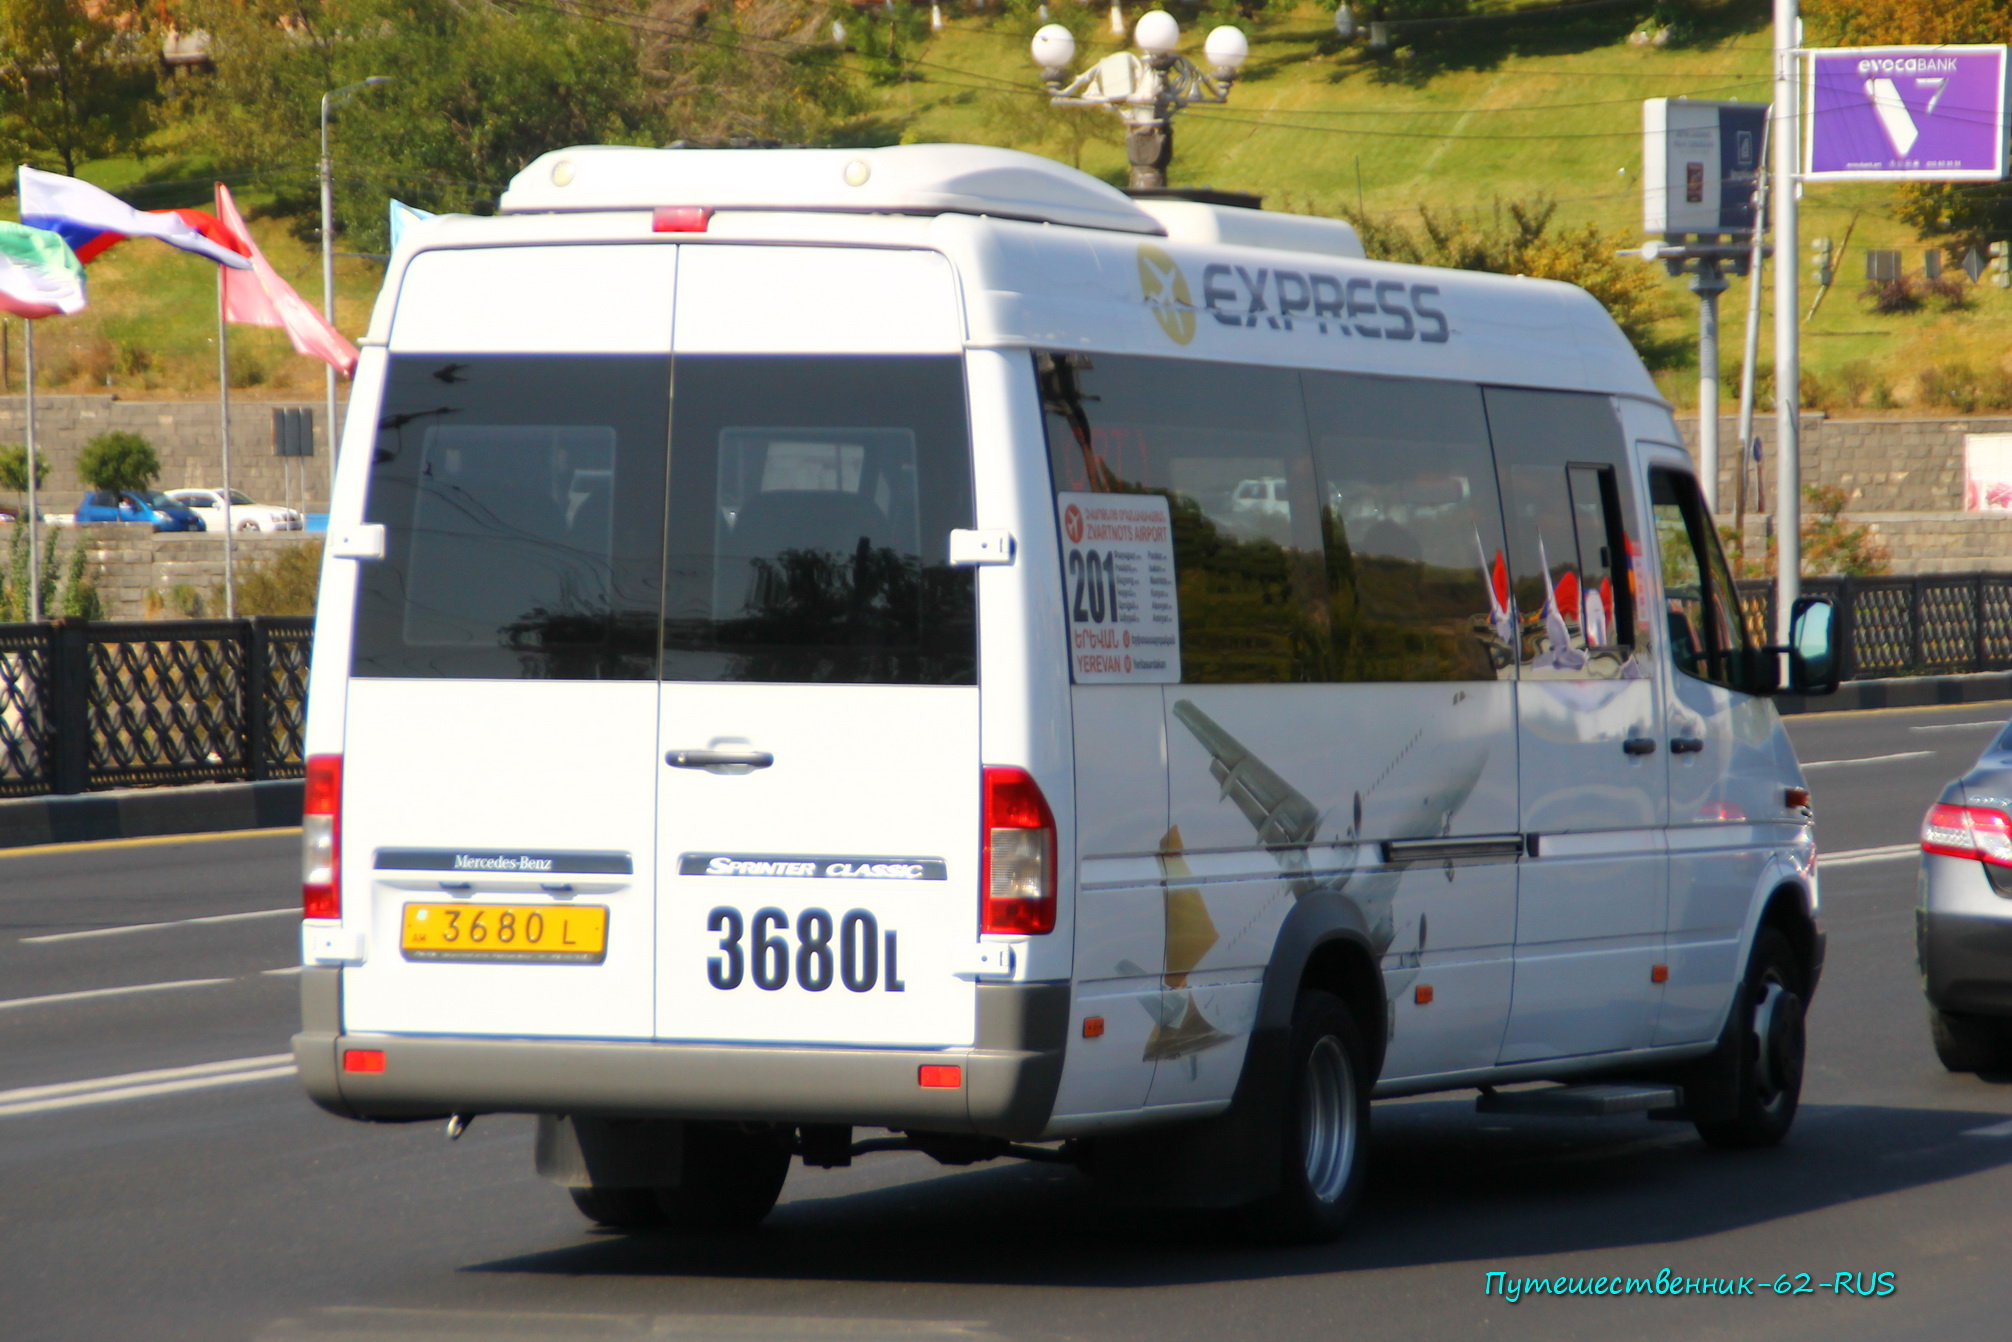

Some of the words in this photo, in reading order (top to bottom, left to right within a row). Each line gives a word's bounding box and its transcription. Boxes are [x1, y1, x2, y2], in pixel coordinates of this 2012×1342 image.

[1858, 57, 1958, 73] evocaBANK
[1203, 262, 1450, 344] EXPRESS
[1087, 523, 1133, 541] ZVARTNOTS
[1134, 525, 1168, 542] AIRPORT
[1069, 548, 1119, 623] 201
[1077, 655, 1121, 673] YEREVAN
[453, 854, 552, 870] Mercedes-Benz
[705, 857, 817, 876] SPRINTER
[825, 863, 923, 879] CLASSIC
[442, 910, 544, 944] 3680
[562, 919, 577, 945] L
